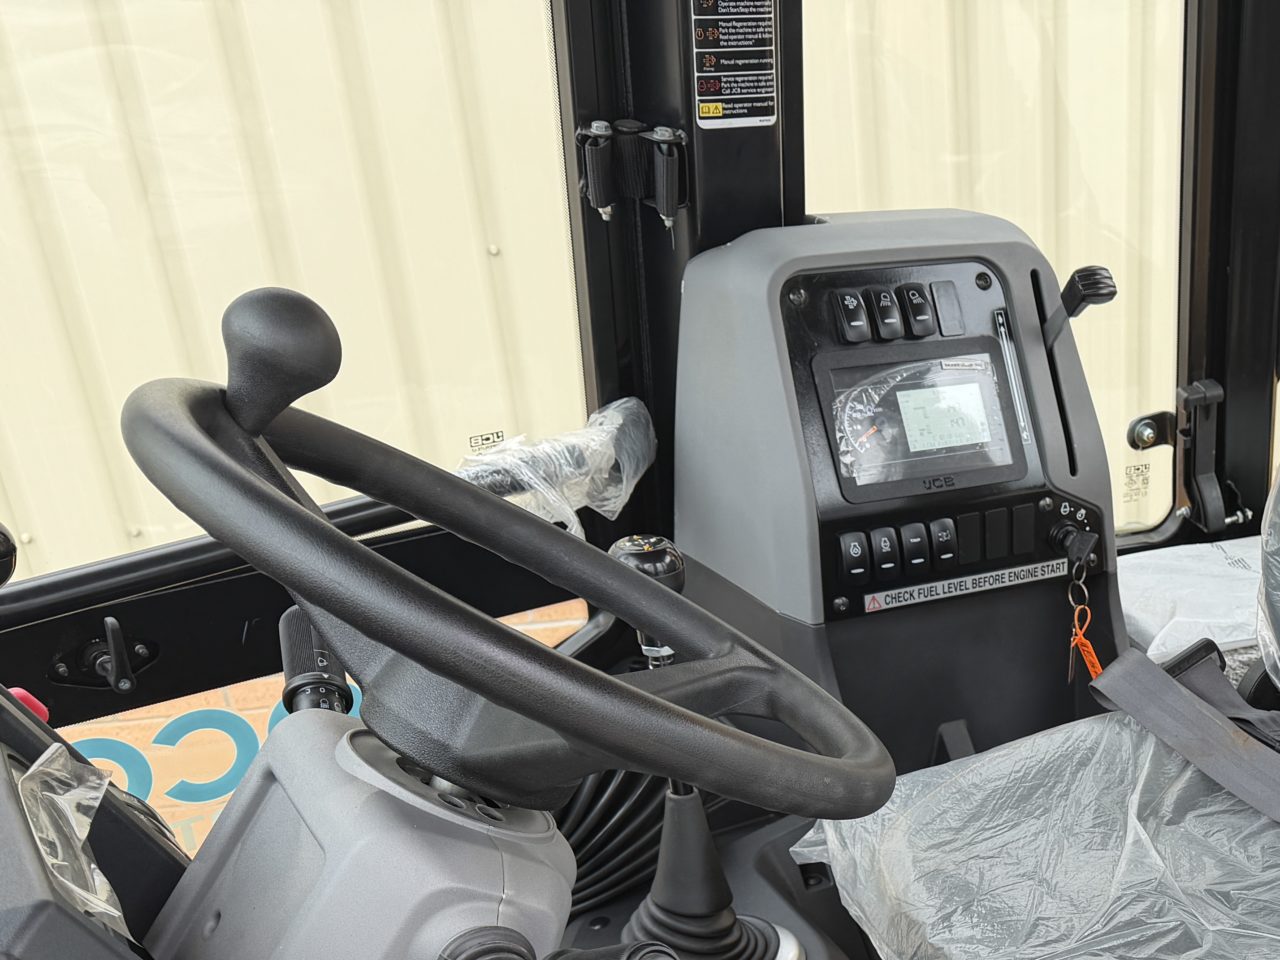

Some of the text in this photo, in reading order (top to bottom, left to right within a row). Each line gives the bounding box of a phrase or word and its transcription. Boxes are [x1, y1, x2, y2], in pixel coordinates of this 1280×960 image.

[884, 561, 1067, 606] CHECK FUEL LEVEL BEFORE ENGINE START
